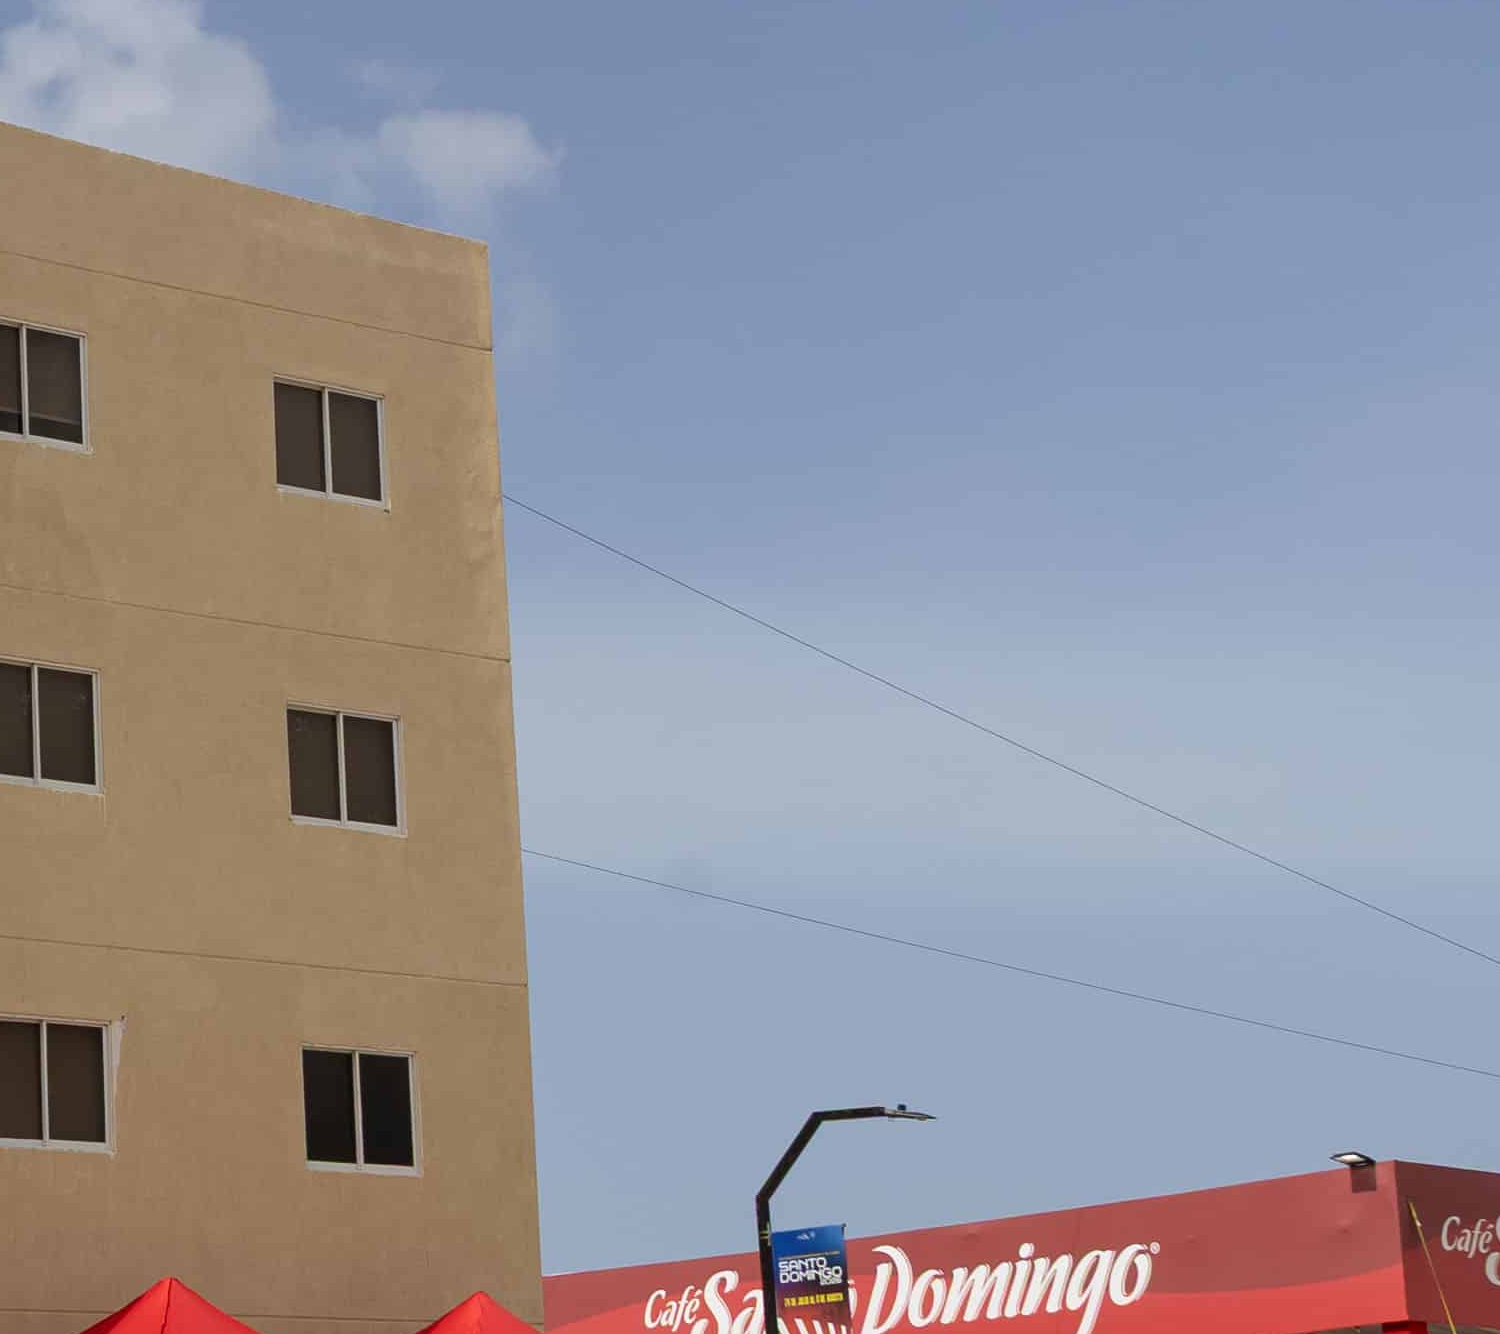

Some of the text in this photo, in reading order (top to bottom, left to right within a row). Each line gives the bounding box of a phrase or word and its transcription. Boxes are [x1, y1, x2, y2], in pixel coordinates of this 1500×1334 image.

[1441, 1216, 1493, 1258] Café
[778, 1257, 827, 1272] SANTO
[643, 1285, 701, 1332] Café
